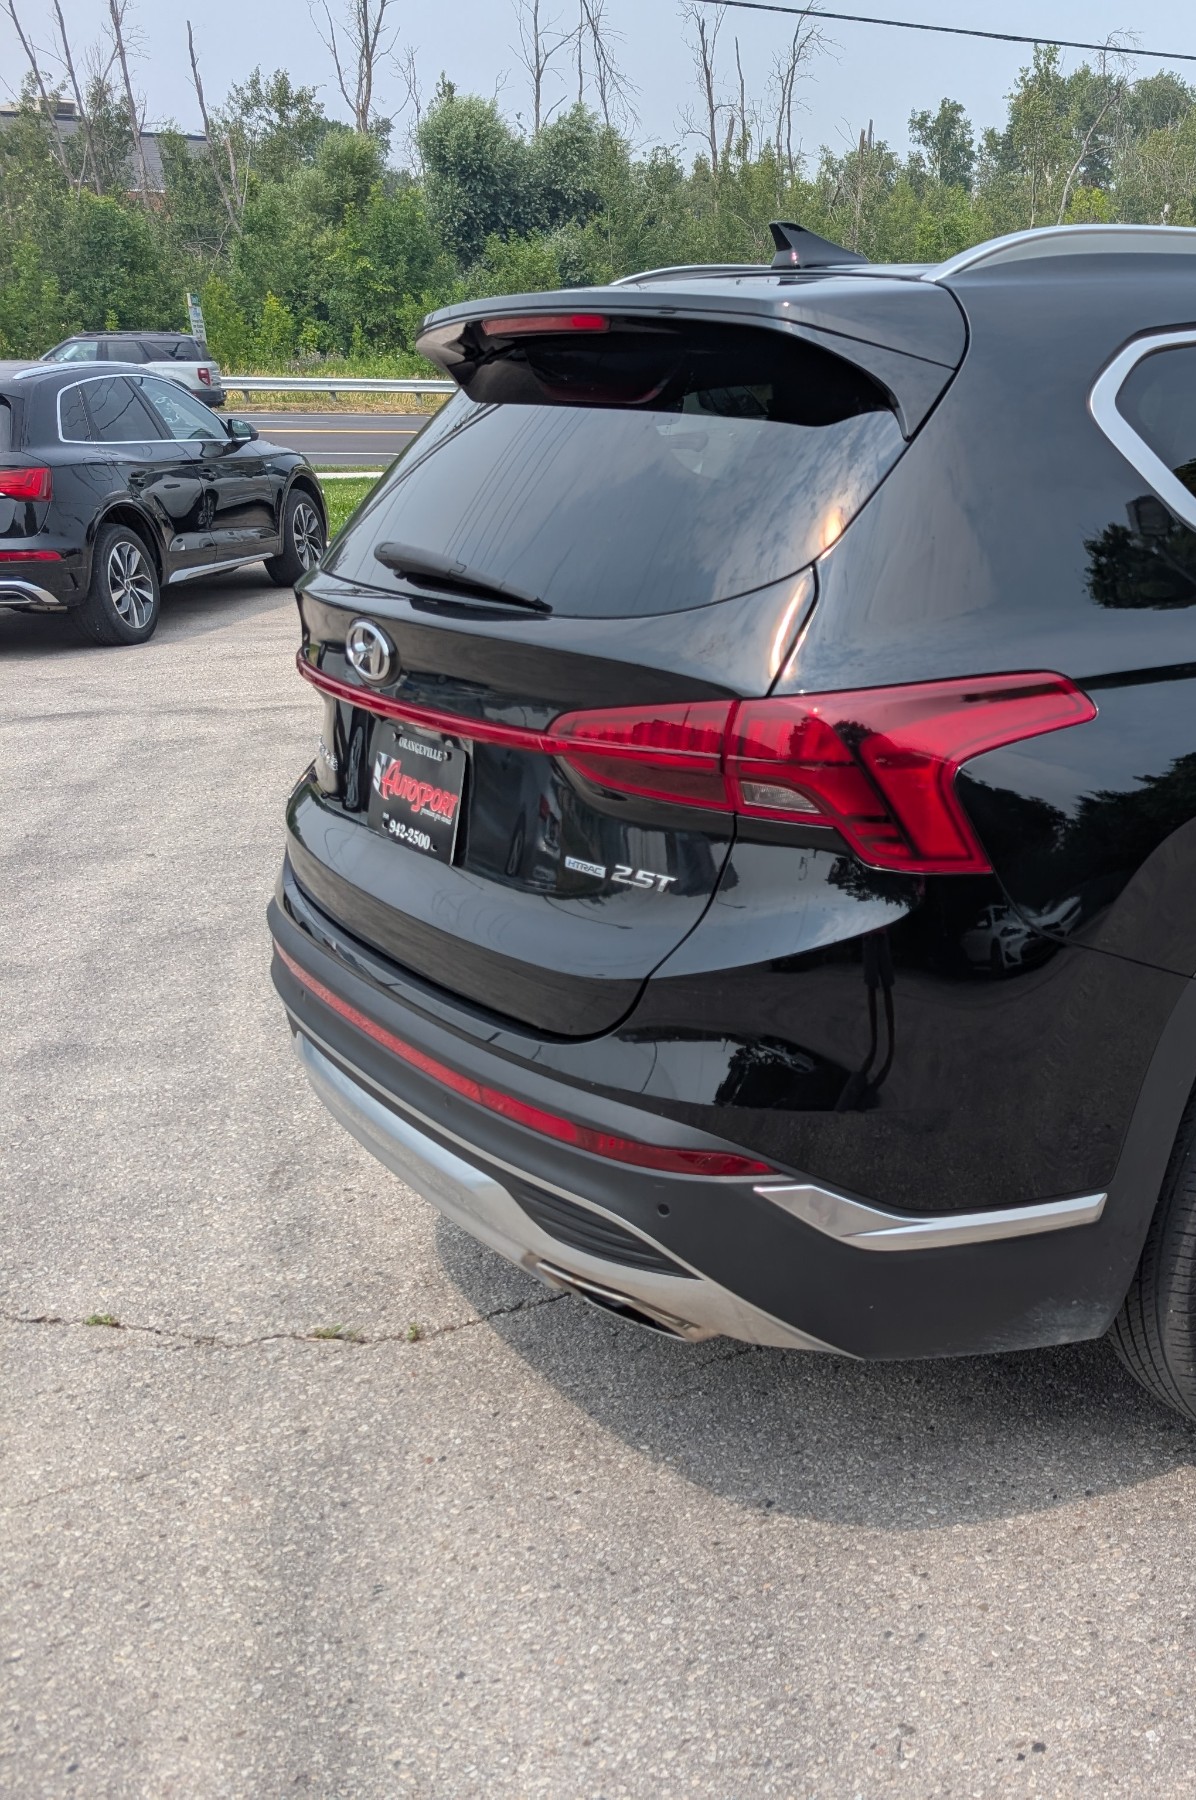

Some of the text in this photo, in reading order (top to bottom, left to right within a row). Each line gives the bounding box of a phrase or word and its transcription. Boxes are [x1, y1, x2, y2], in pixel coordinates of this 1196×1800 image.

[398, 738, 443, 762] ORANGEVILLE
[382, 760, 459, 819] AUTOSPORT
[388, 818, 431, 850] 942-2500
[567, 859, 603, 876] HTRAC
